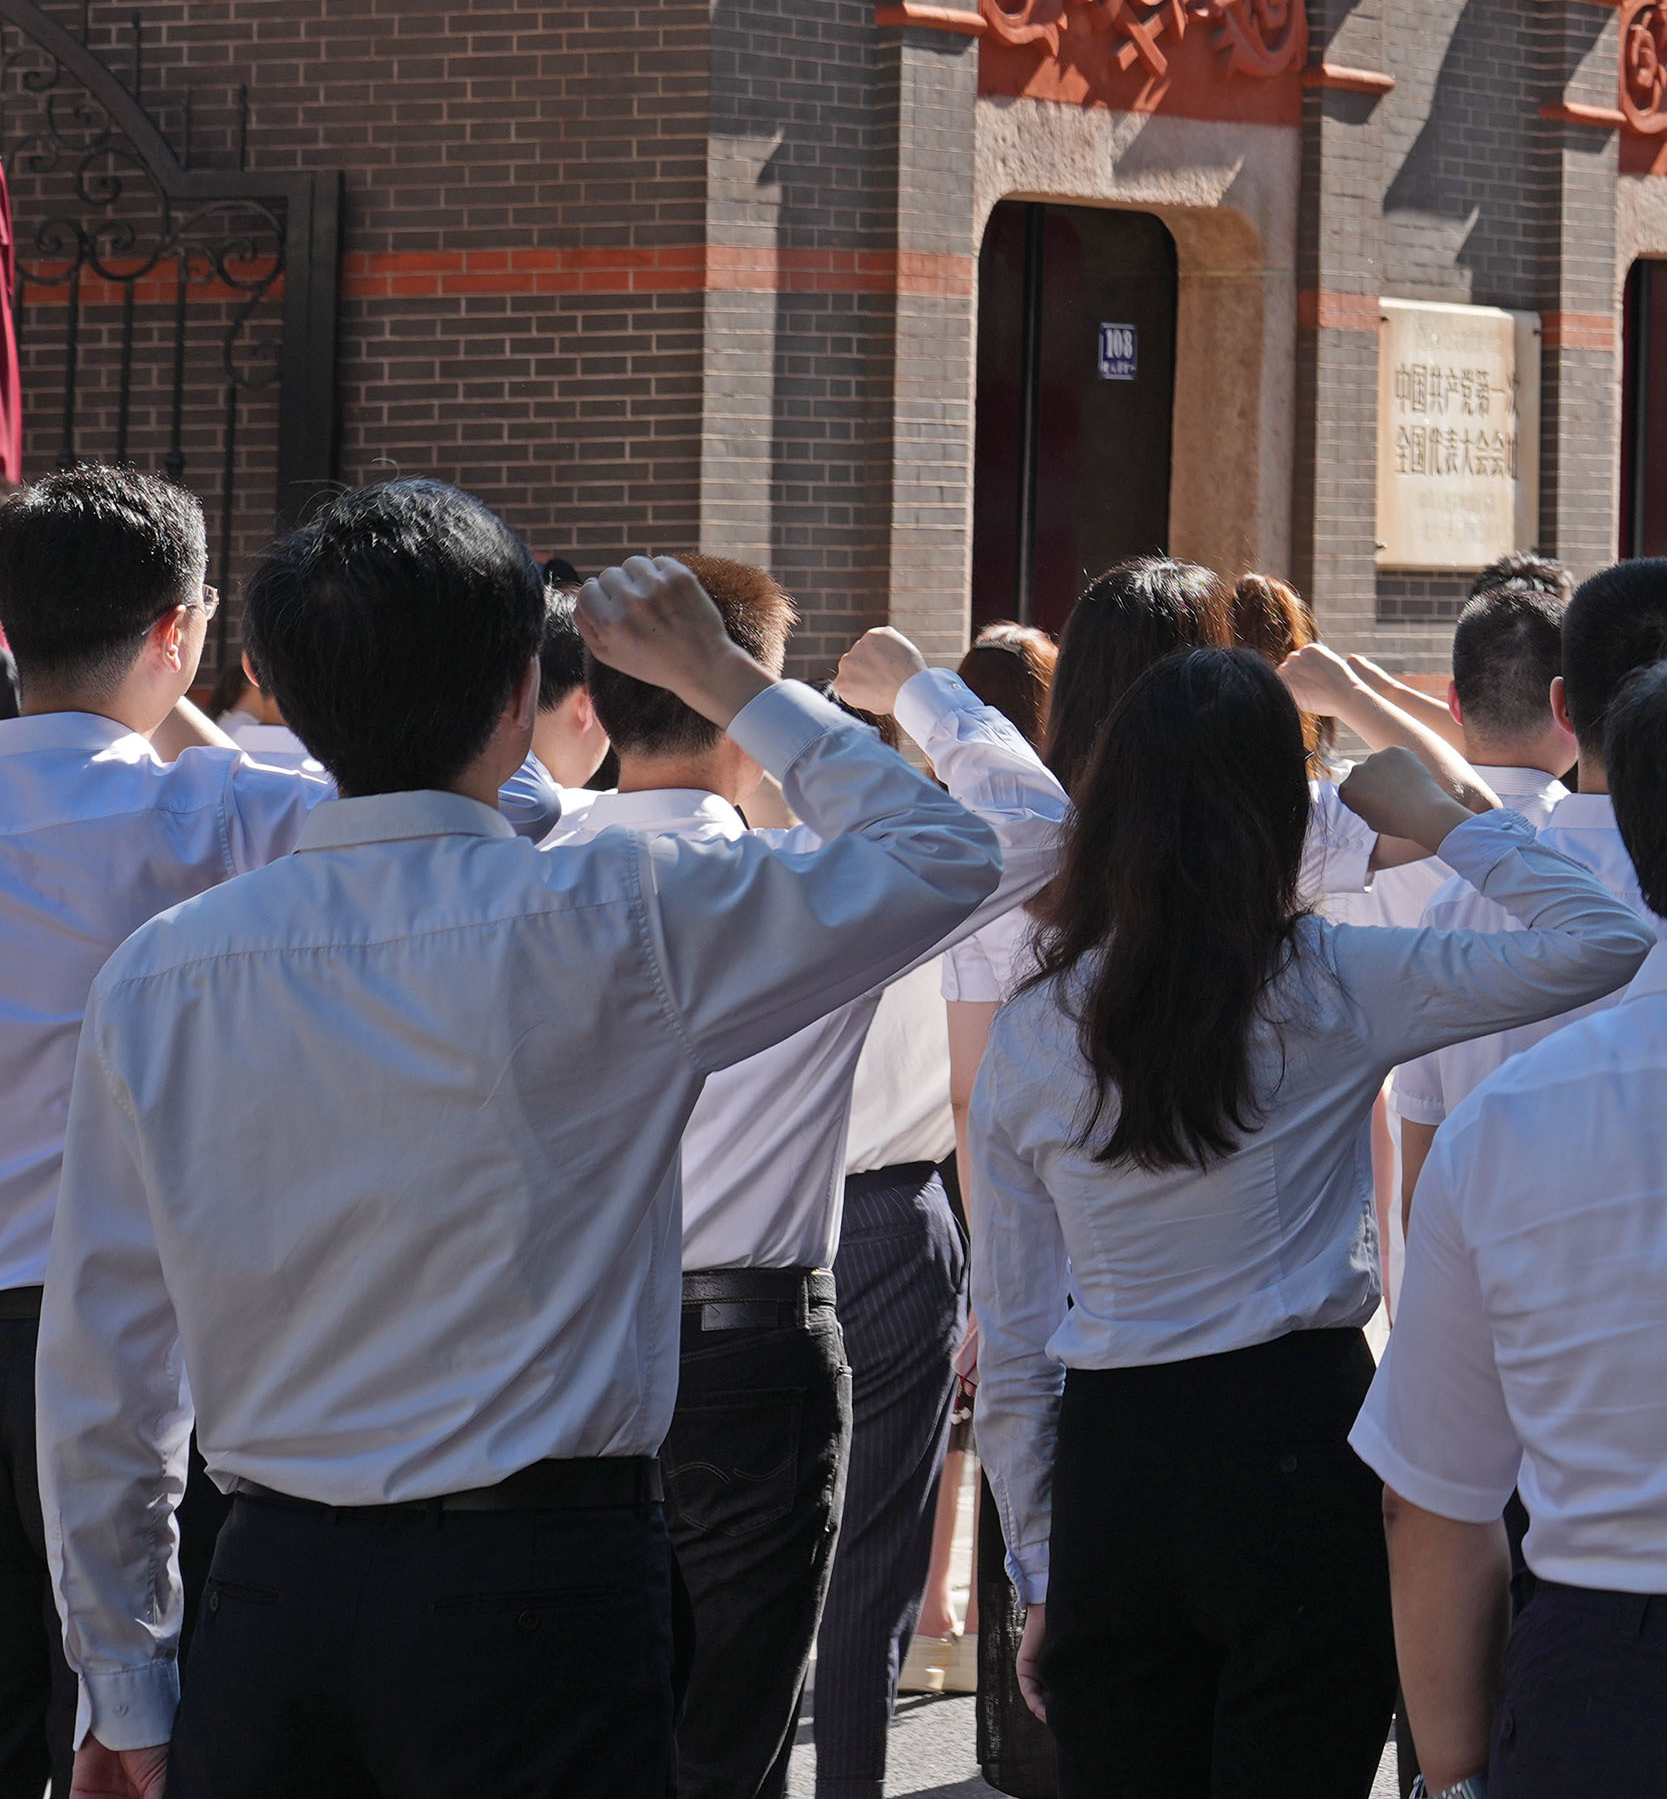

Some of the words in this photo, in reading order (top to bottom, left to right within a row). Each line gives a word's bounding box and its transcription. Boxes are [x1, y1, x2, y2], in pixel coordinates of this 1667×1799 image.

[1104, 328, 1134, 360] 108
[1394, 363, 1521, 418] 中国共产党第一次
